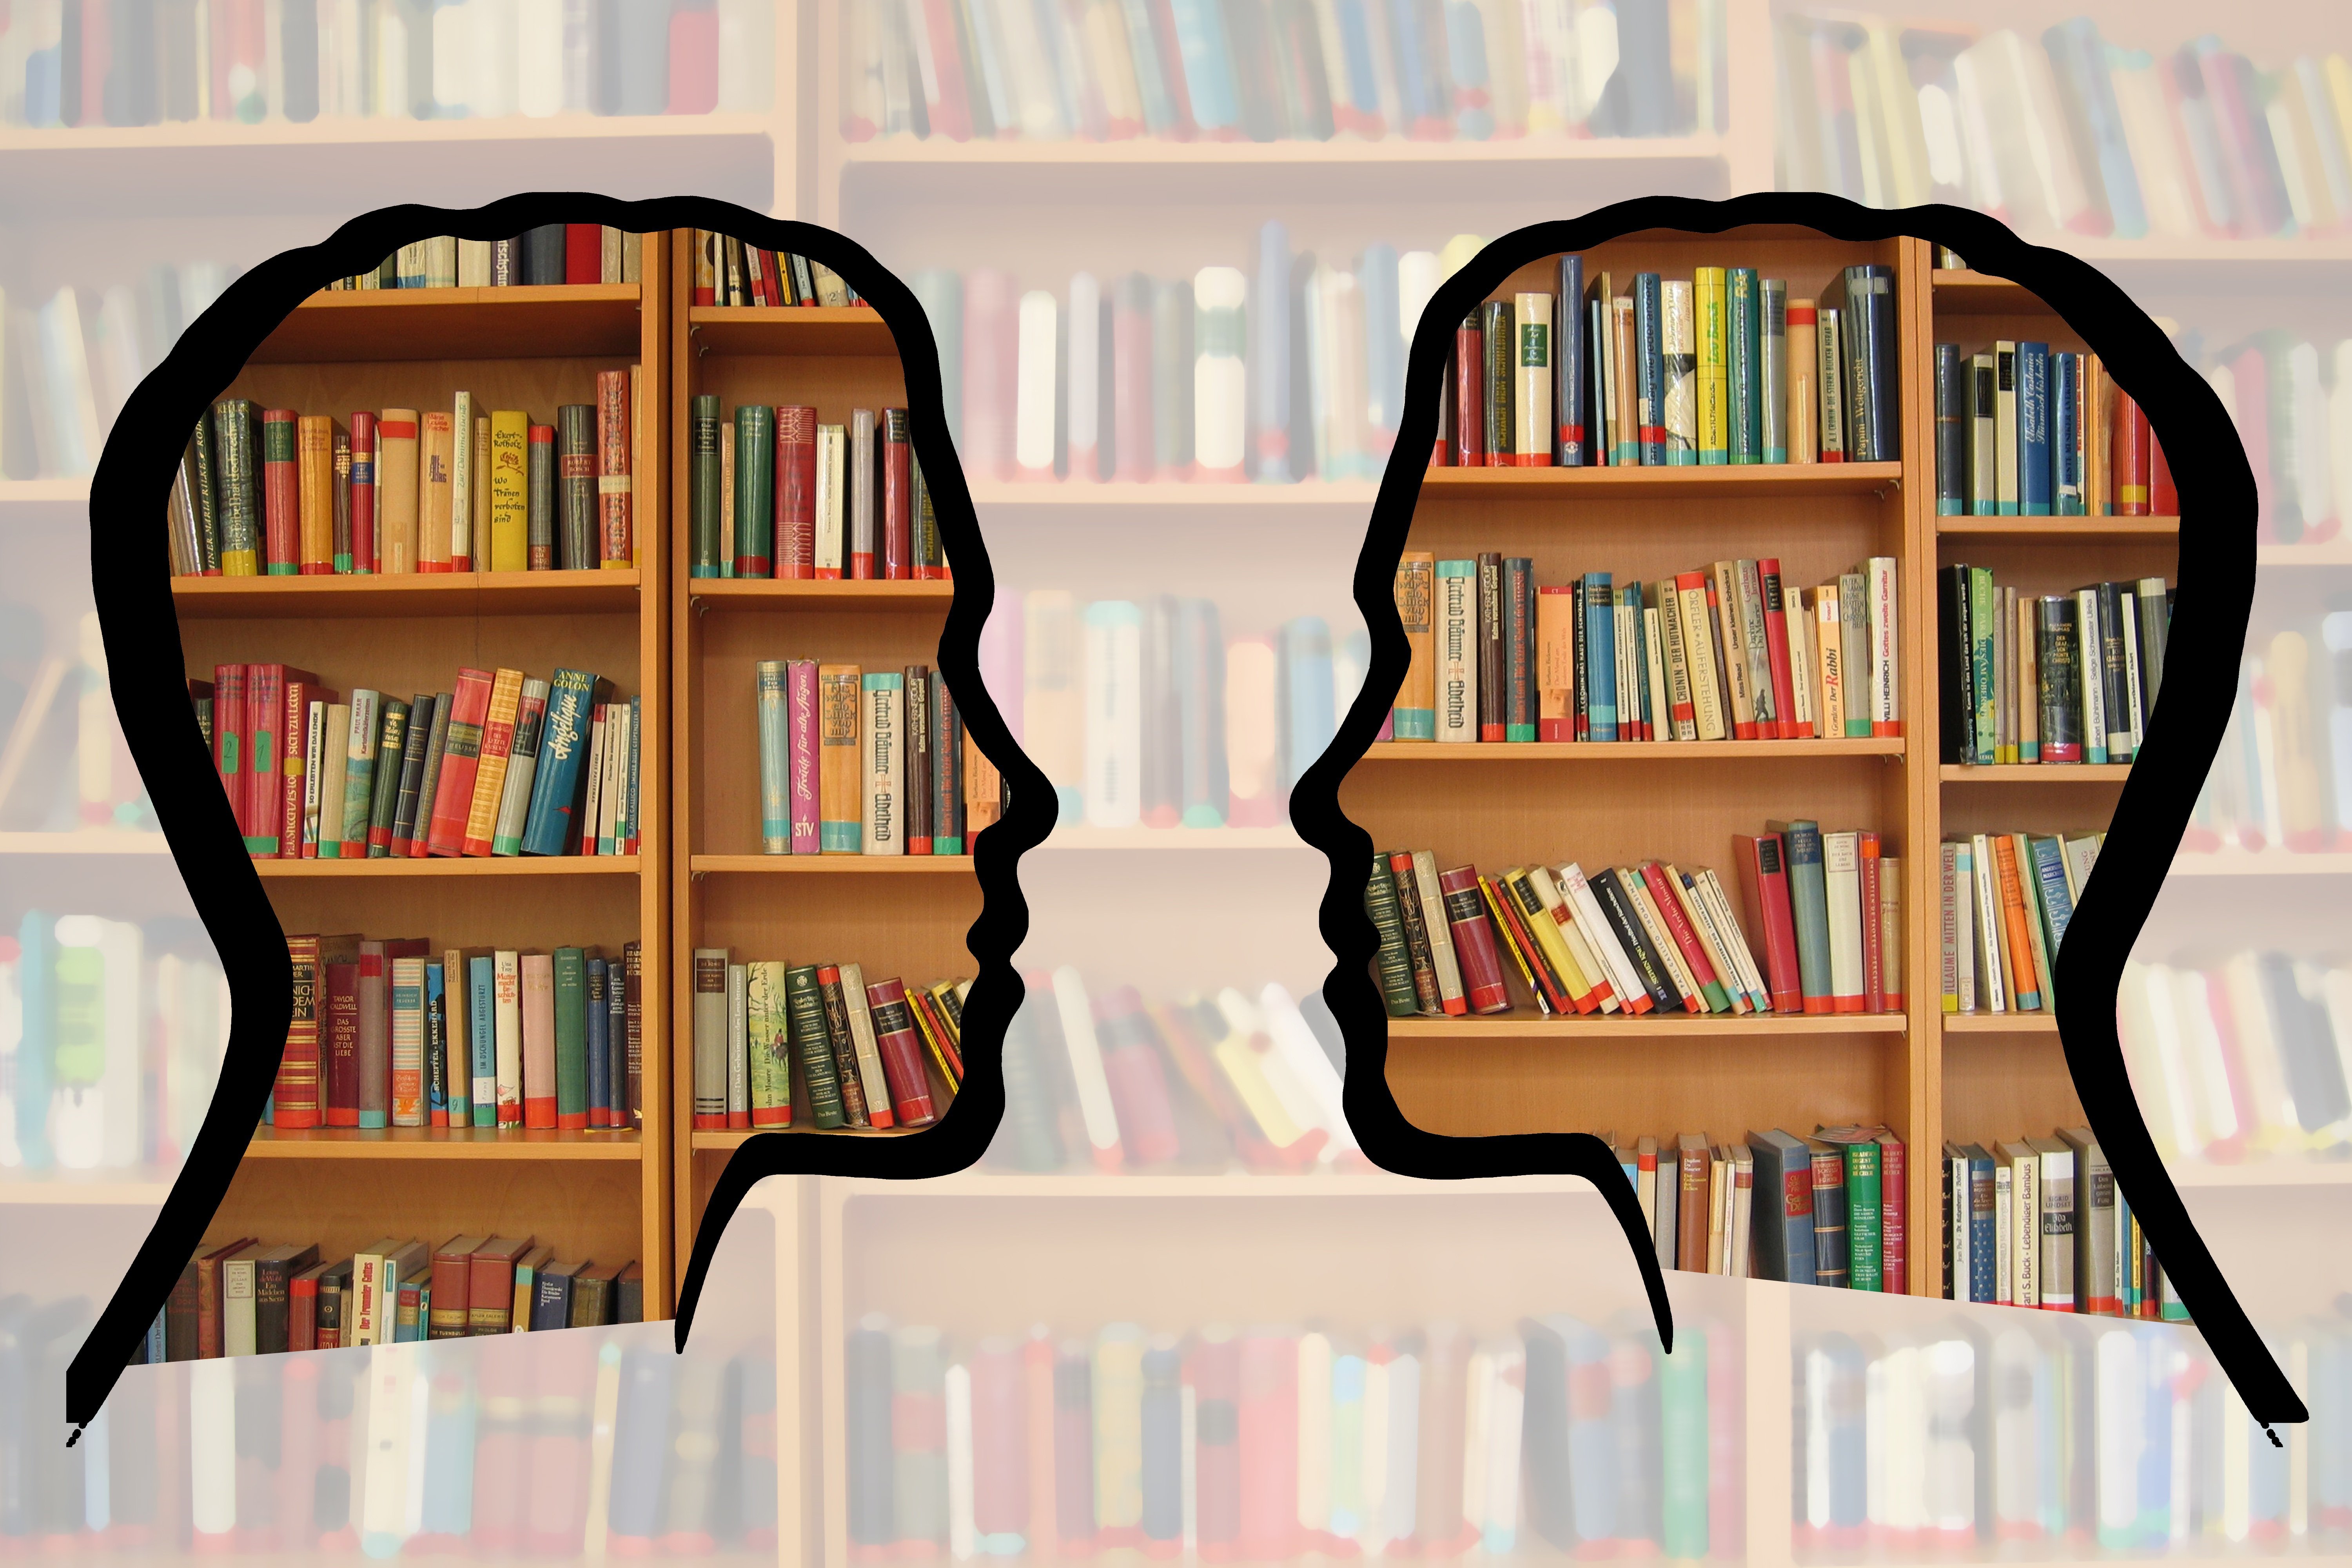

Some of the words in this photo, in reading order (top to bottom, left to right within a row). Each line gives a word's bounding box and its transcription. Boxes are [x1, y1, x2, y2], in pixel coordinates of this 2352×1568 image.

[1646, 325, 1656, 355] jeder
[1707, 344, 1719, 364] Leo
[1826, 372, 1835, 393] STERNE
[1854, 358, 1866, 417] Weltgericht
[2025, 399, 2035, 442] Elisabeth
[494, 439, 522, 450] Rotholz
[1857, 424, 1868, 456] Papini
[199, 463, 208, 496] RILKE
[494, 498, 525, 510] verboten
[203, 501, 212, 534] MARIA
[494, 512, 511, 523] sind
[1723, 569, 1733, 602] Schicksal
[1741, 567, 1751, 603] Gasthaus
[1665, 597, 1680, 645] HUTMACHER
[1727, 603, 1736, 627] kleines
[1731, 628, 1739, 649] Unser
[1671, 648, 1682, 662] DER
[559, 671, 587, 683] ANNE
[1825, 648, 1838, 687] Rabbi
[1980, 662, 1987, 675] AM
[554, 679, 590, 692] GOLON
[1673, 670, 1687, 701] CRONIN
[1695, 639, 1715, 731] AUFERSTEHUNG
[547, 693, 582, 760] Angélique
[1830, 705, 1838, 731] Gordon
[224, 740, 233, 759] 2
[309, 795, 315, 804] SO
[795, 822, 815, 837] STV
[1943, 848, 1953, 873] WELT
[1943, 875, 1953, 892] DER
[1626, 882, 1654, 929] THOMASINA
[1944, 896, 1953, 906] IN
[1944, 910, 1954, 944] MITTEN
[1654, 935, 1674, 967] GALLICO
[1671, 969, 1685, 988] PAUL
[2022, 1164, 2031, 1200] Bambus
[2022, 1201, 2033, 1250] Lebendiger
[361, 1262, 373, 1283] Gottes
[2022, 1257, 2031, 1279] Buck
[2022, 1280, 2031, 1290] S.
[359, 1318, 370, 1329] Der
